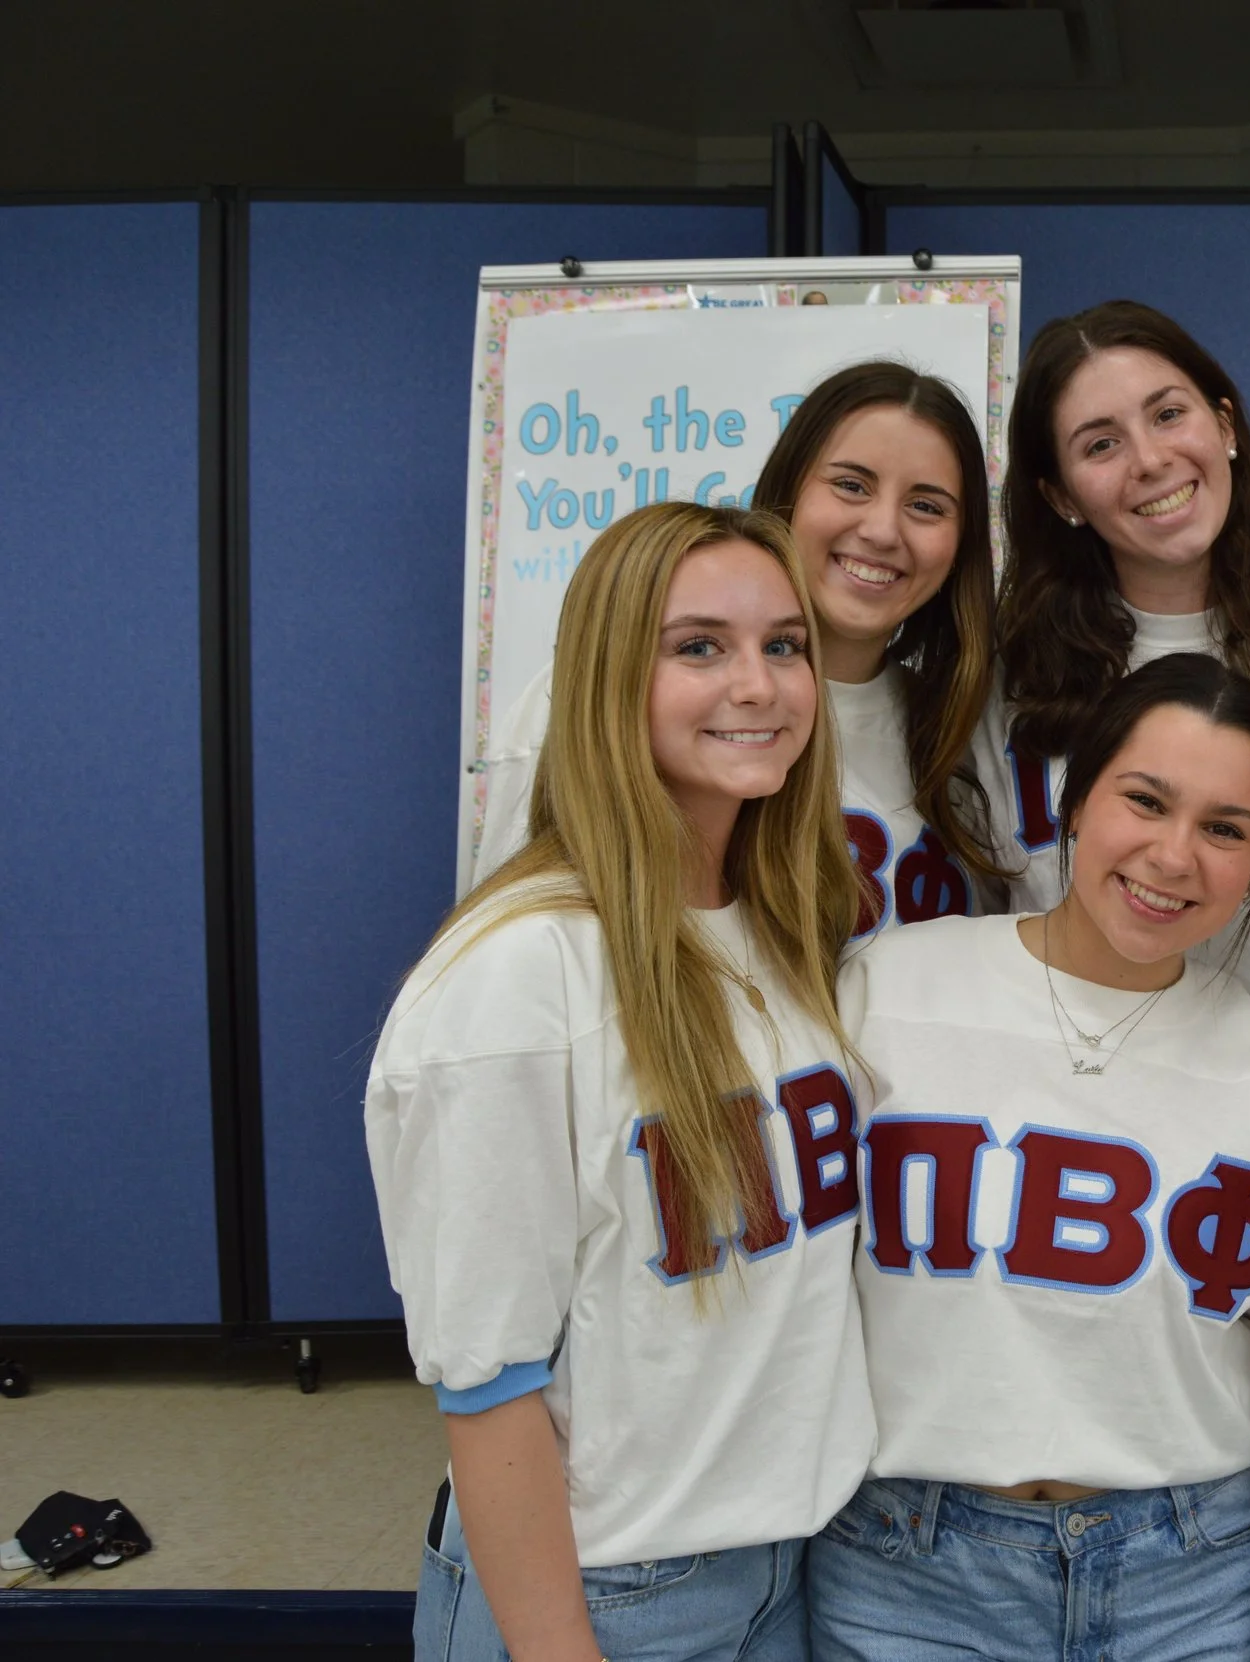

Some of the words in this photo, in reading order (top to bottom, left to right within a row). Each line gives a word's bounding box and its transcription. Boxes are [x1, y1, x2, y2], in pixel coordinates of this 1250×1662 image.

[519, 388, 619, 456] Oh,
[643, 385, 746, 452] the
[516, 462, 670, 531] You'll
